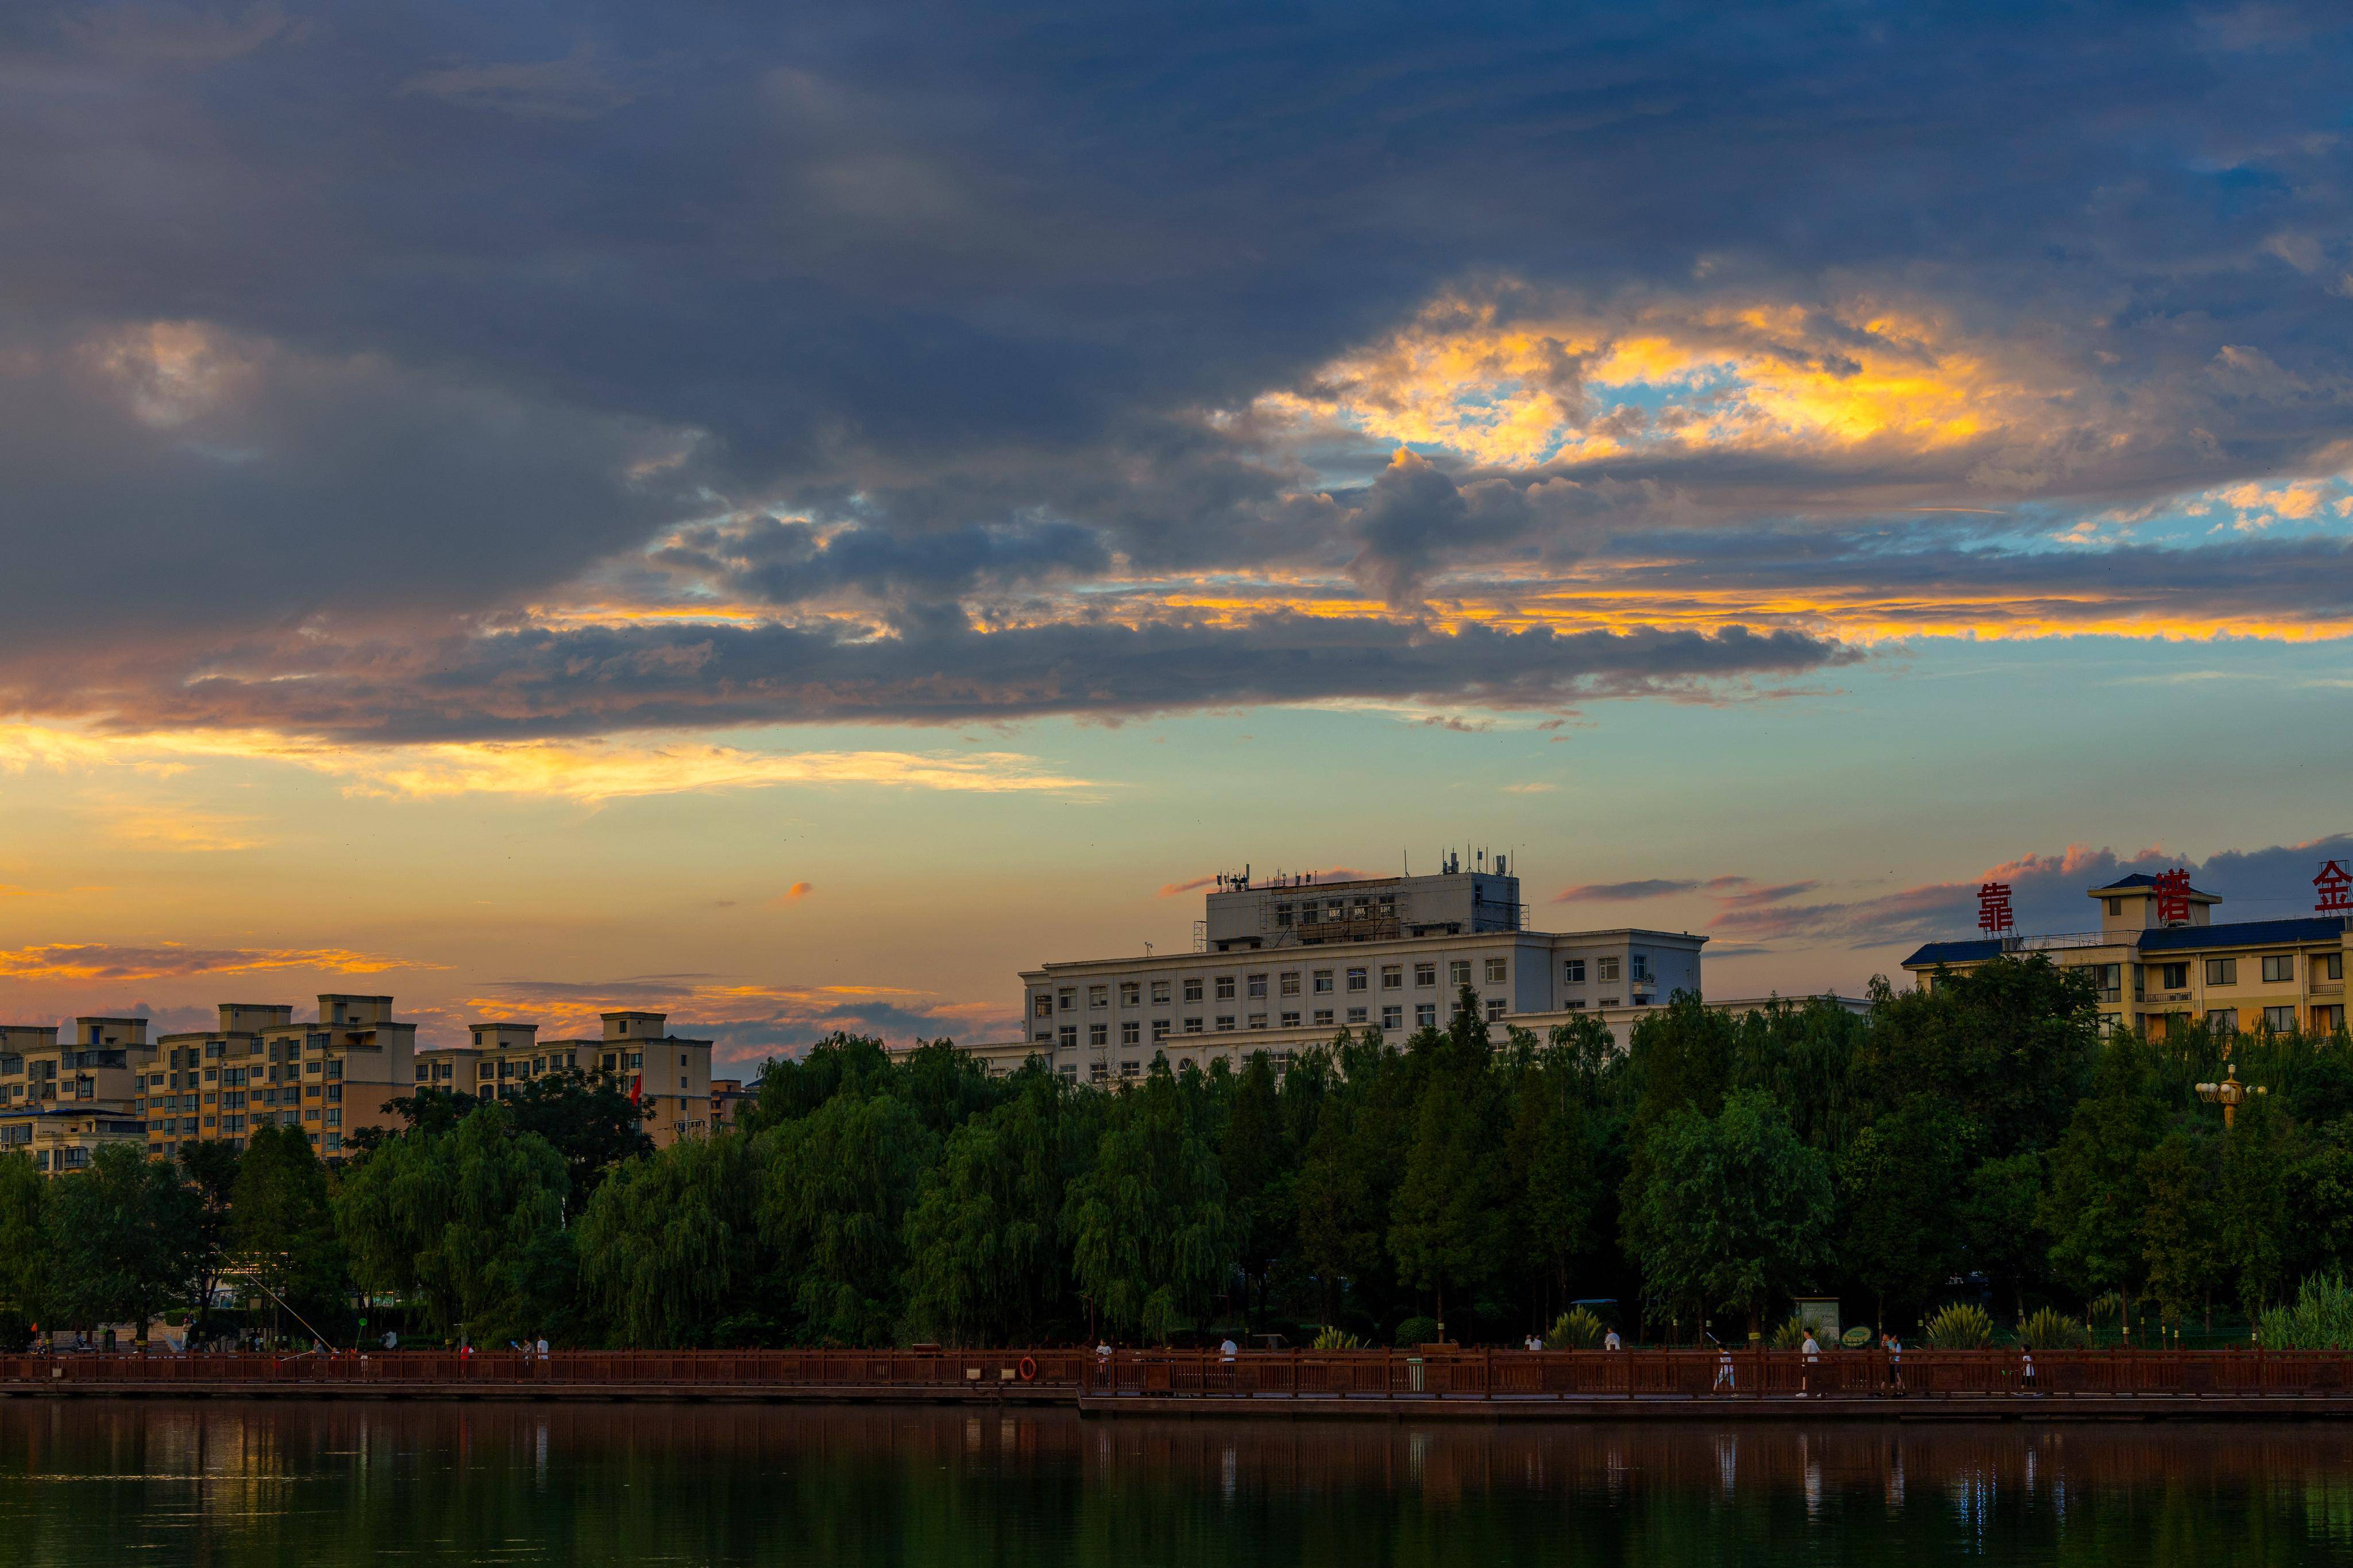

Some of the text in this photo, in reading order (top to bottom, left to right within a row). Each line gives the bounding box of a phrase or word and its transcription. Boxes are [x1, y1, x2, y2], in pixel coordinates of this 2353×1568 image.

[1977, 860, 2353, 931] 靠 谱 金
